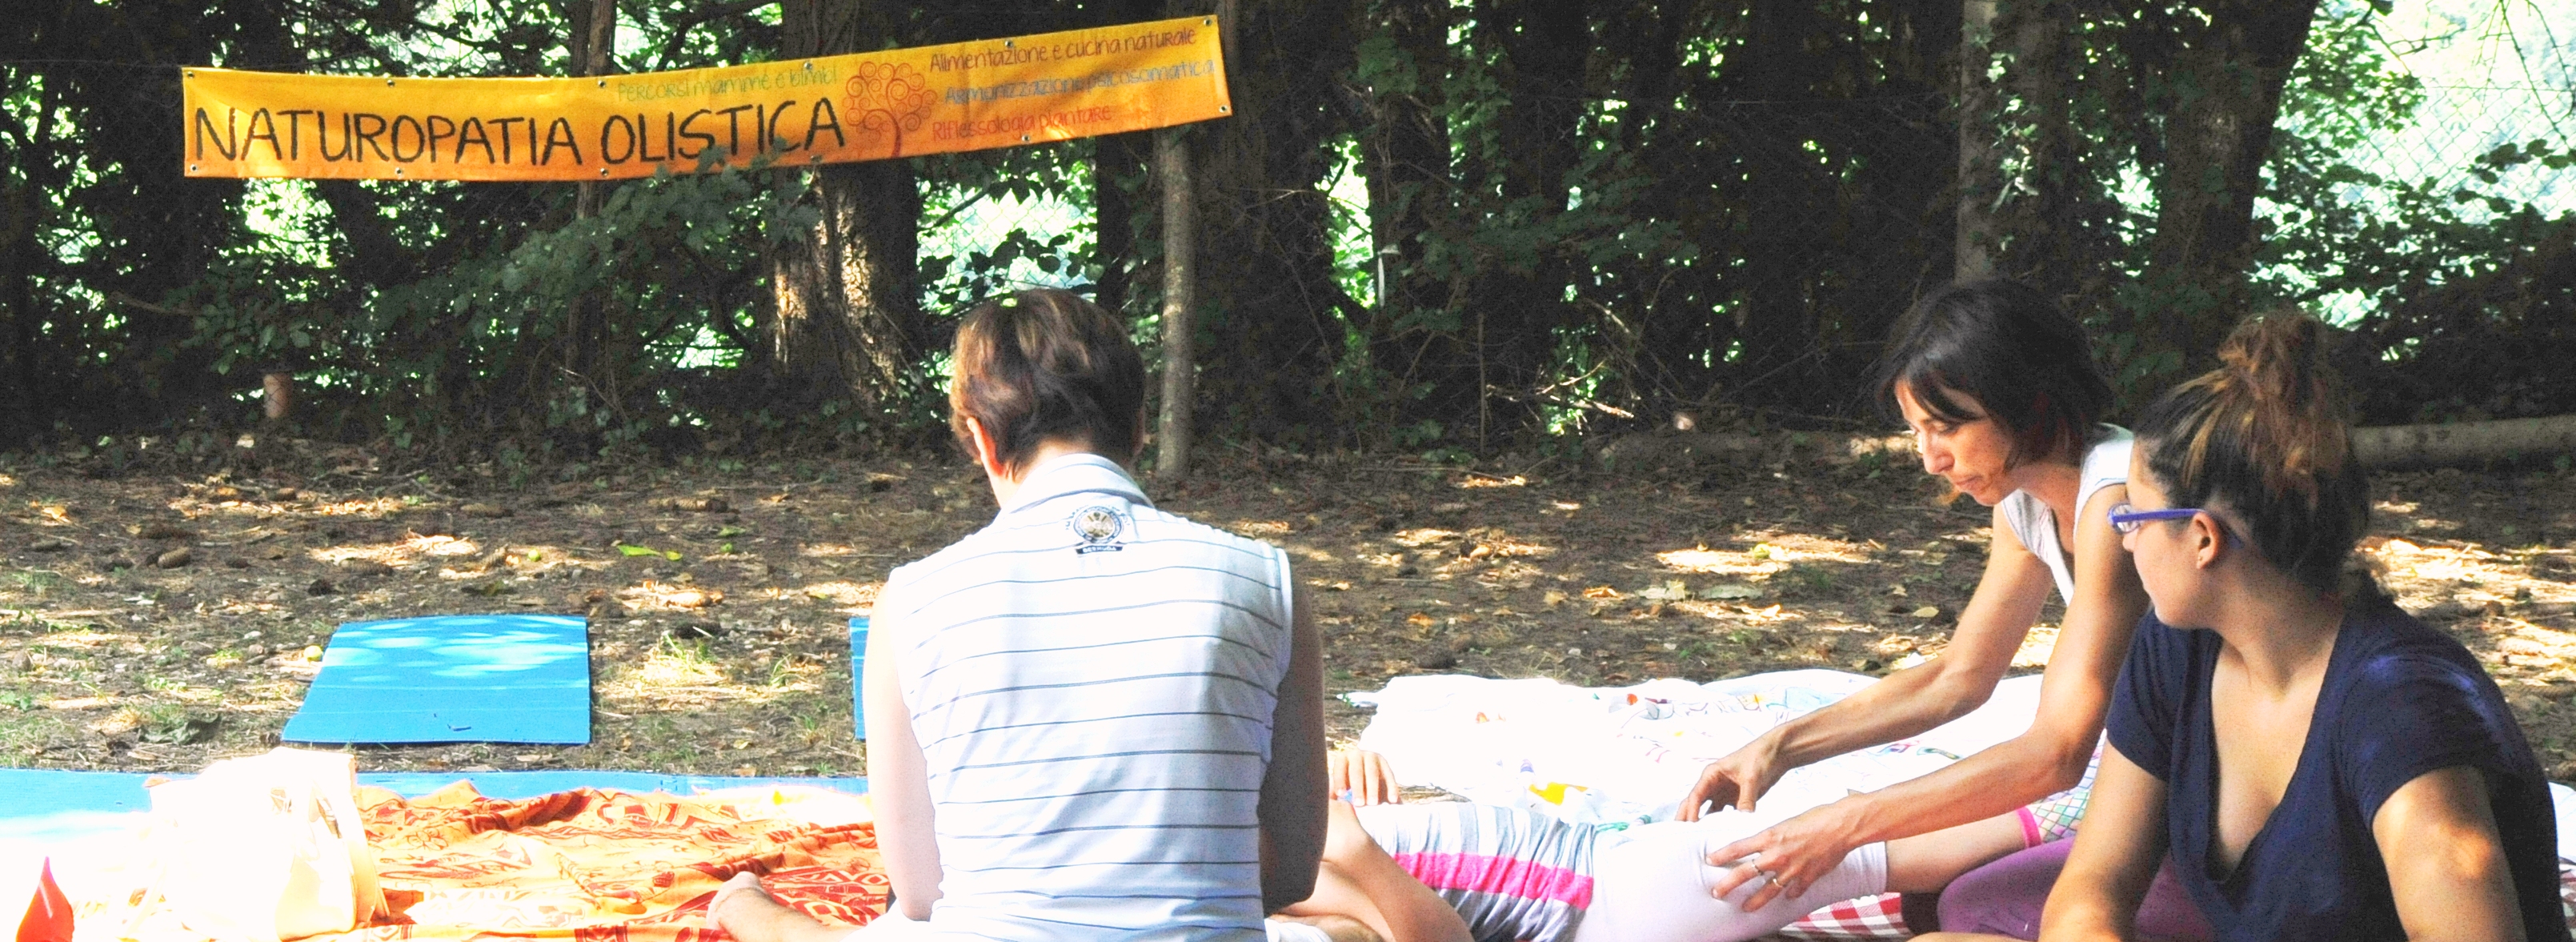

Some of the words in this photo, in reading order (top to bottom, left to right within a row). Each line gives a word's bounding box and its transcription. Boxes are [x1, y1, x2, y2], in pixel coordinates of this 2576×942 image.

[929, 44, 1048, 73] Alimentazione
[1052, 44, 1063, 60] e
[1065, 38, 1121, 58] cucina
[1124, 27, 1197, 52] naturale
[775, 72, 786, 89] e
[195, 106, 583, 166] NATUROPATIA
[600, 97, 845, 165] OLISTICA
[932, 113, 1036, 142] Riflessologia
[1040, 105, 1112, 134] plantare
